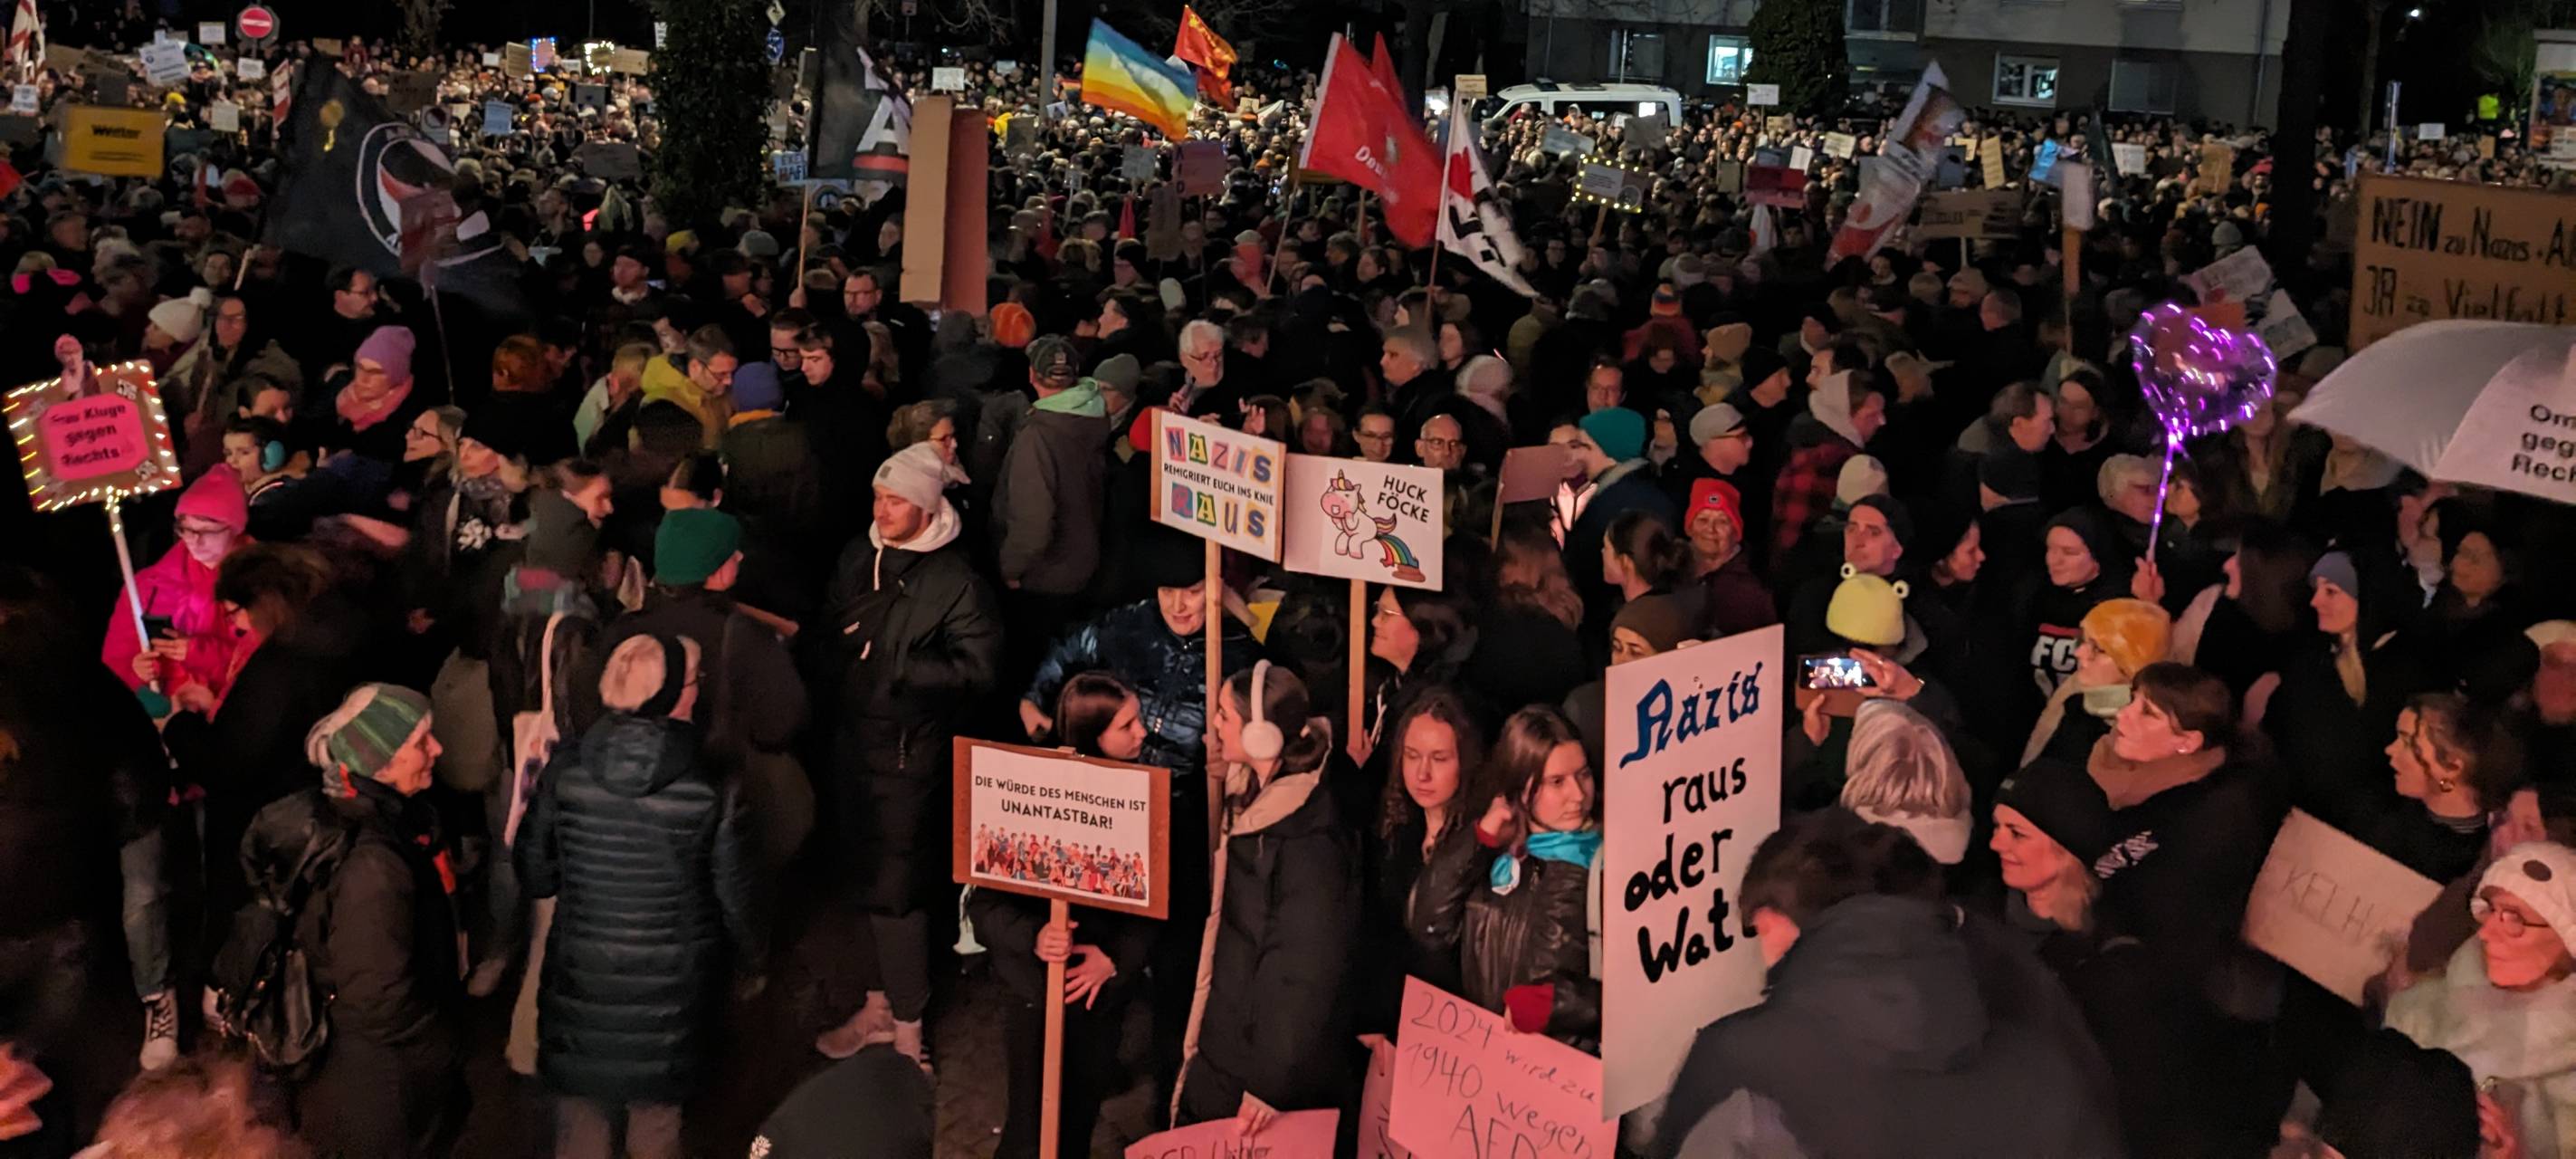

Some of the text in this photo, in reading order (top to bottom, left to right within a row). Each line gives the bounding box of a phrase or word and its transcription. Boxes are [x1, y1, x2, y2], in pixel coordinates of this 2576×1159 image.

[2371, 196, 2443, 253] NEIN
[2445, 235, 2466, 256] zu
[1164, 463, 1274, 506] REMIGRIERT EUCH INS KNIE
[1166, 427, 1274, 487] NAZIS
[1171, 483, 1267, 541] RAUS
[1377, 492, 1430, 523] FÖCKE
[1383, 474, 1428, 503] HUCK
[2030, 636, 2079, 671] FC
[1619, 662, 1763, 770] Nazis
[975, 775, 1147, 812] DIE WÜRDE DES MENSCHEN IST
[1001, 799, 1113, 829] UNANTASTBAR!
[1662, 757, 1747, 824] raus
[1624, 829, 1733, 912] oder
[1403, 1042, 1483, 1099] 1940
[1411, 991, 1596, 1104] 2024 wird zu
